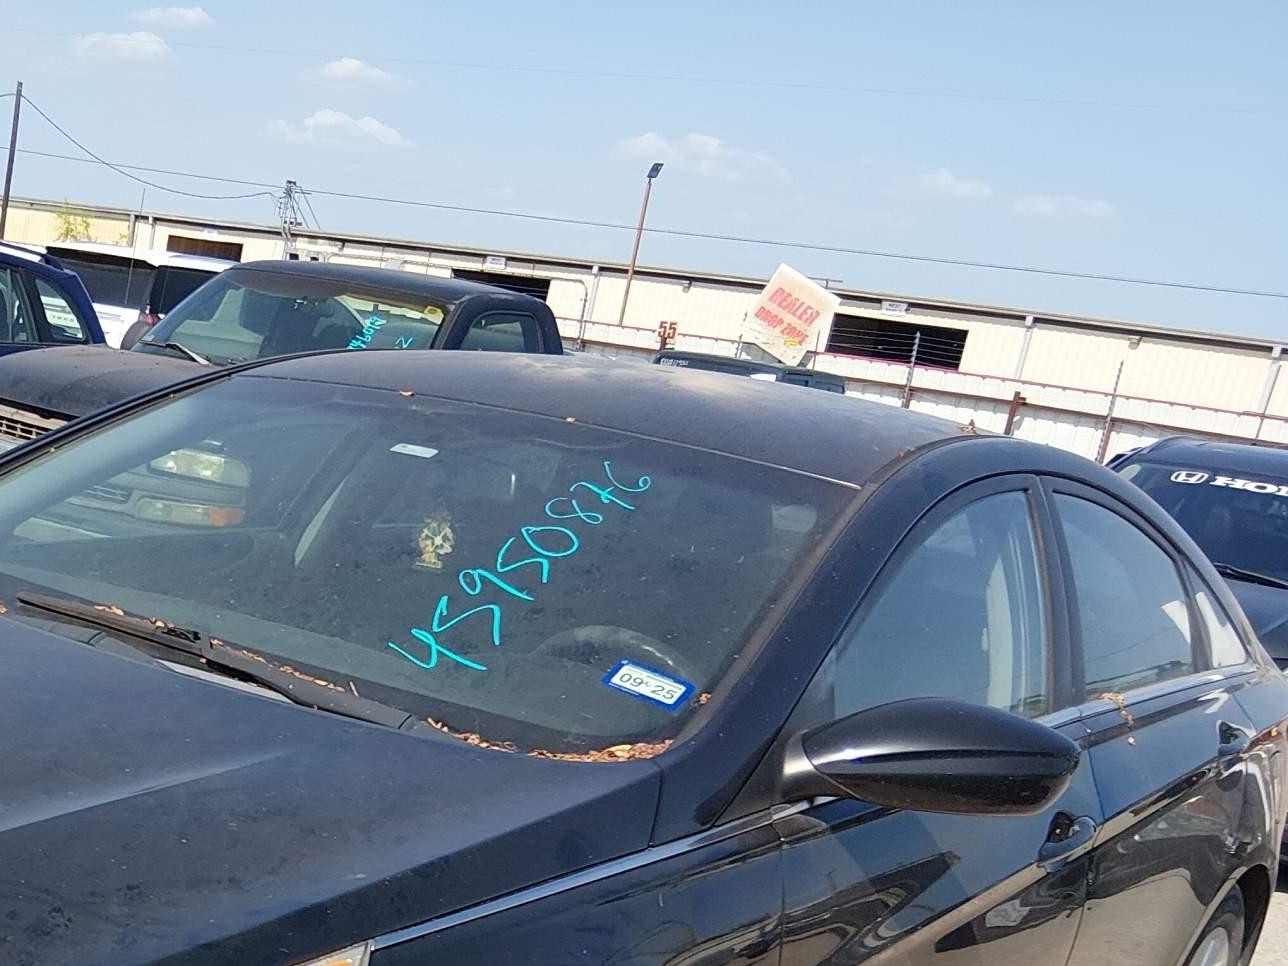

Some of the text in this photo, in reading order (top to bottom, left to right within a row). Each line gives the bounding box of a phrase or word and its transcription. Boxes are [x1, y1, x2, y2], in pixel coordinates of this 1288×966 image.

[754, 306, 784, 328] DROP
[768, 287, 820, 326] DEALER
[657, 321, 678, 339] 55
[387, 460, 651, 672] 45950876
[618, 673, 678, 700] 09 25
